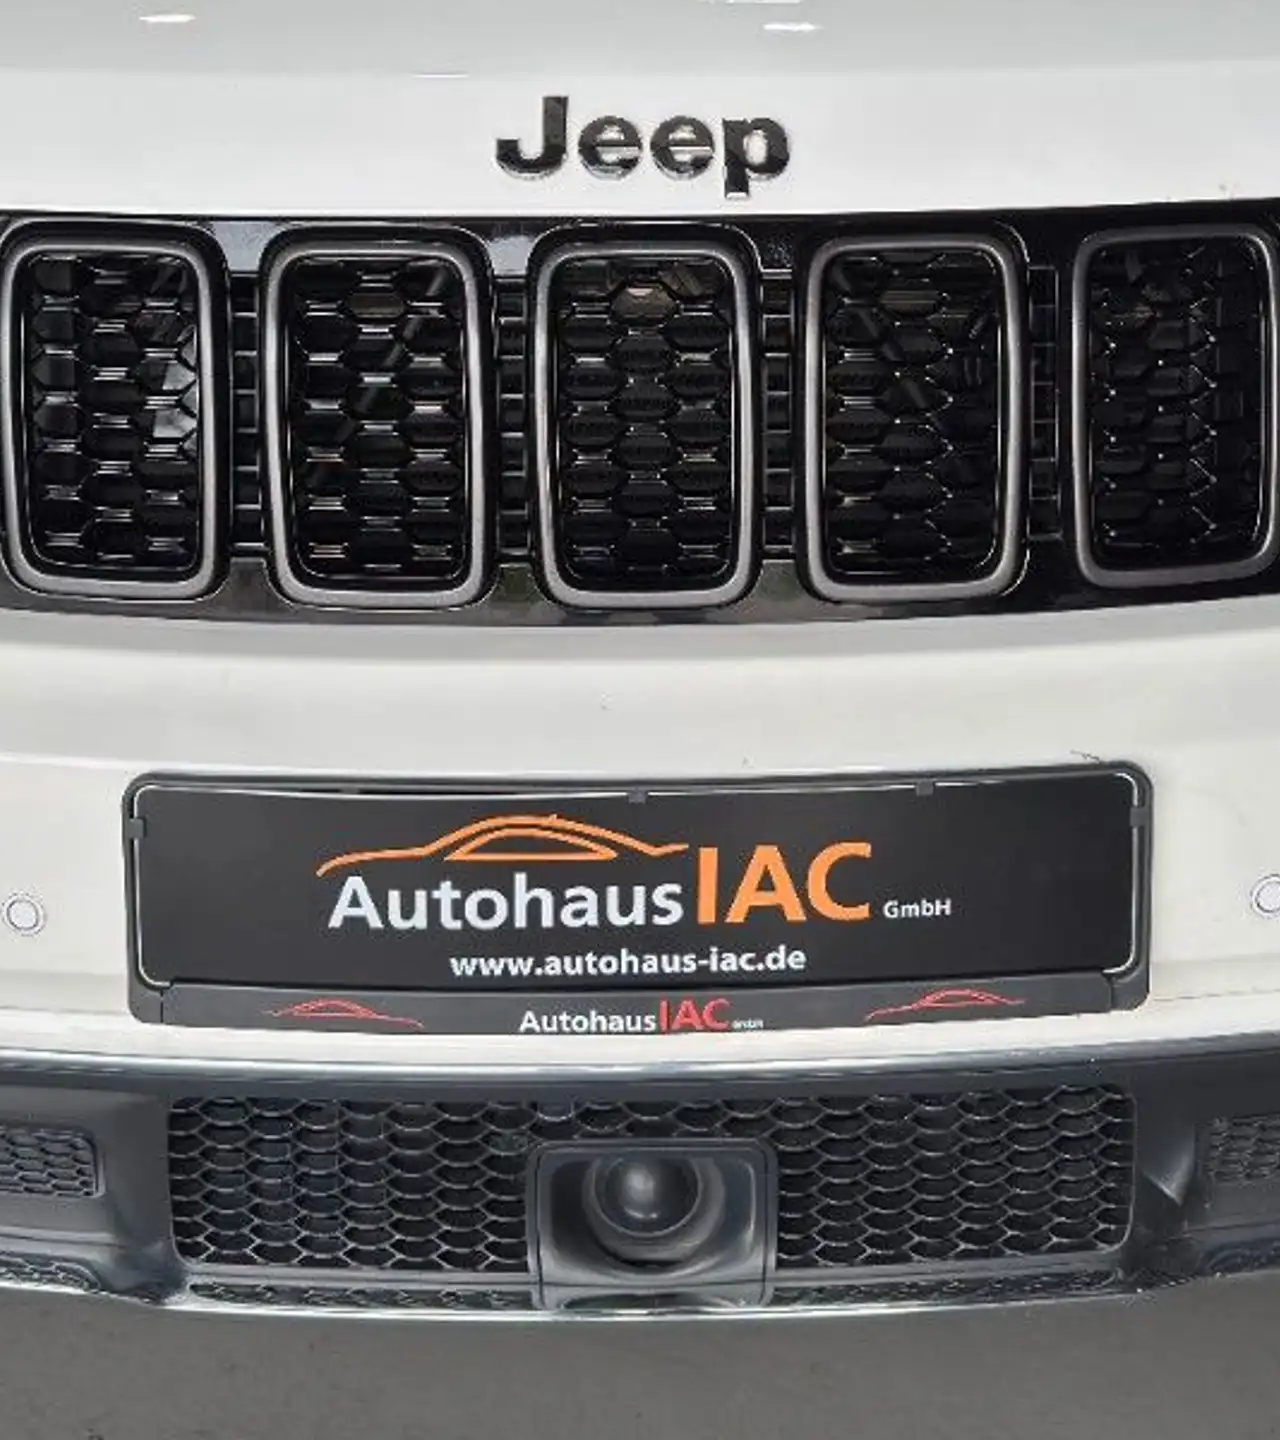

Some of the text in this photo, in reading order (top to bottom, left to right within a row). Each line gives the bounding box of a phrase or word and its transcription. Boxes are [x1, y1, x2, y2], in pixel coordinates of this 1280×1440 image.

[495, 95, 790, 200] Jeep
[327, 842, 952, 931] Autohaus IAC GmbH
[449, 945, 807, 977] www.autohaus-iac.de
[519, 1010, 657, 1033] Autohaus
[658, 997, 730, 1032] IAC
